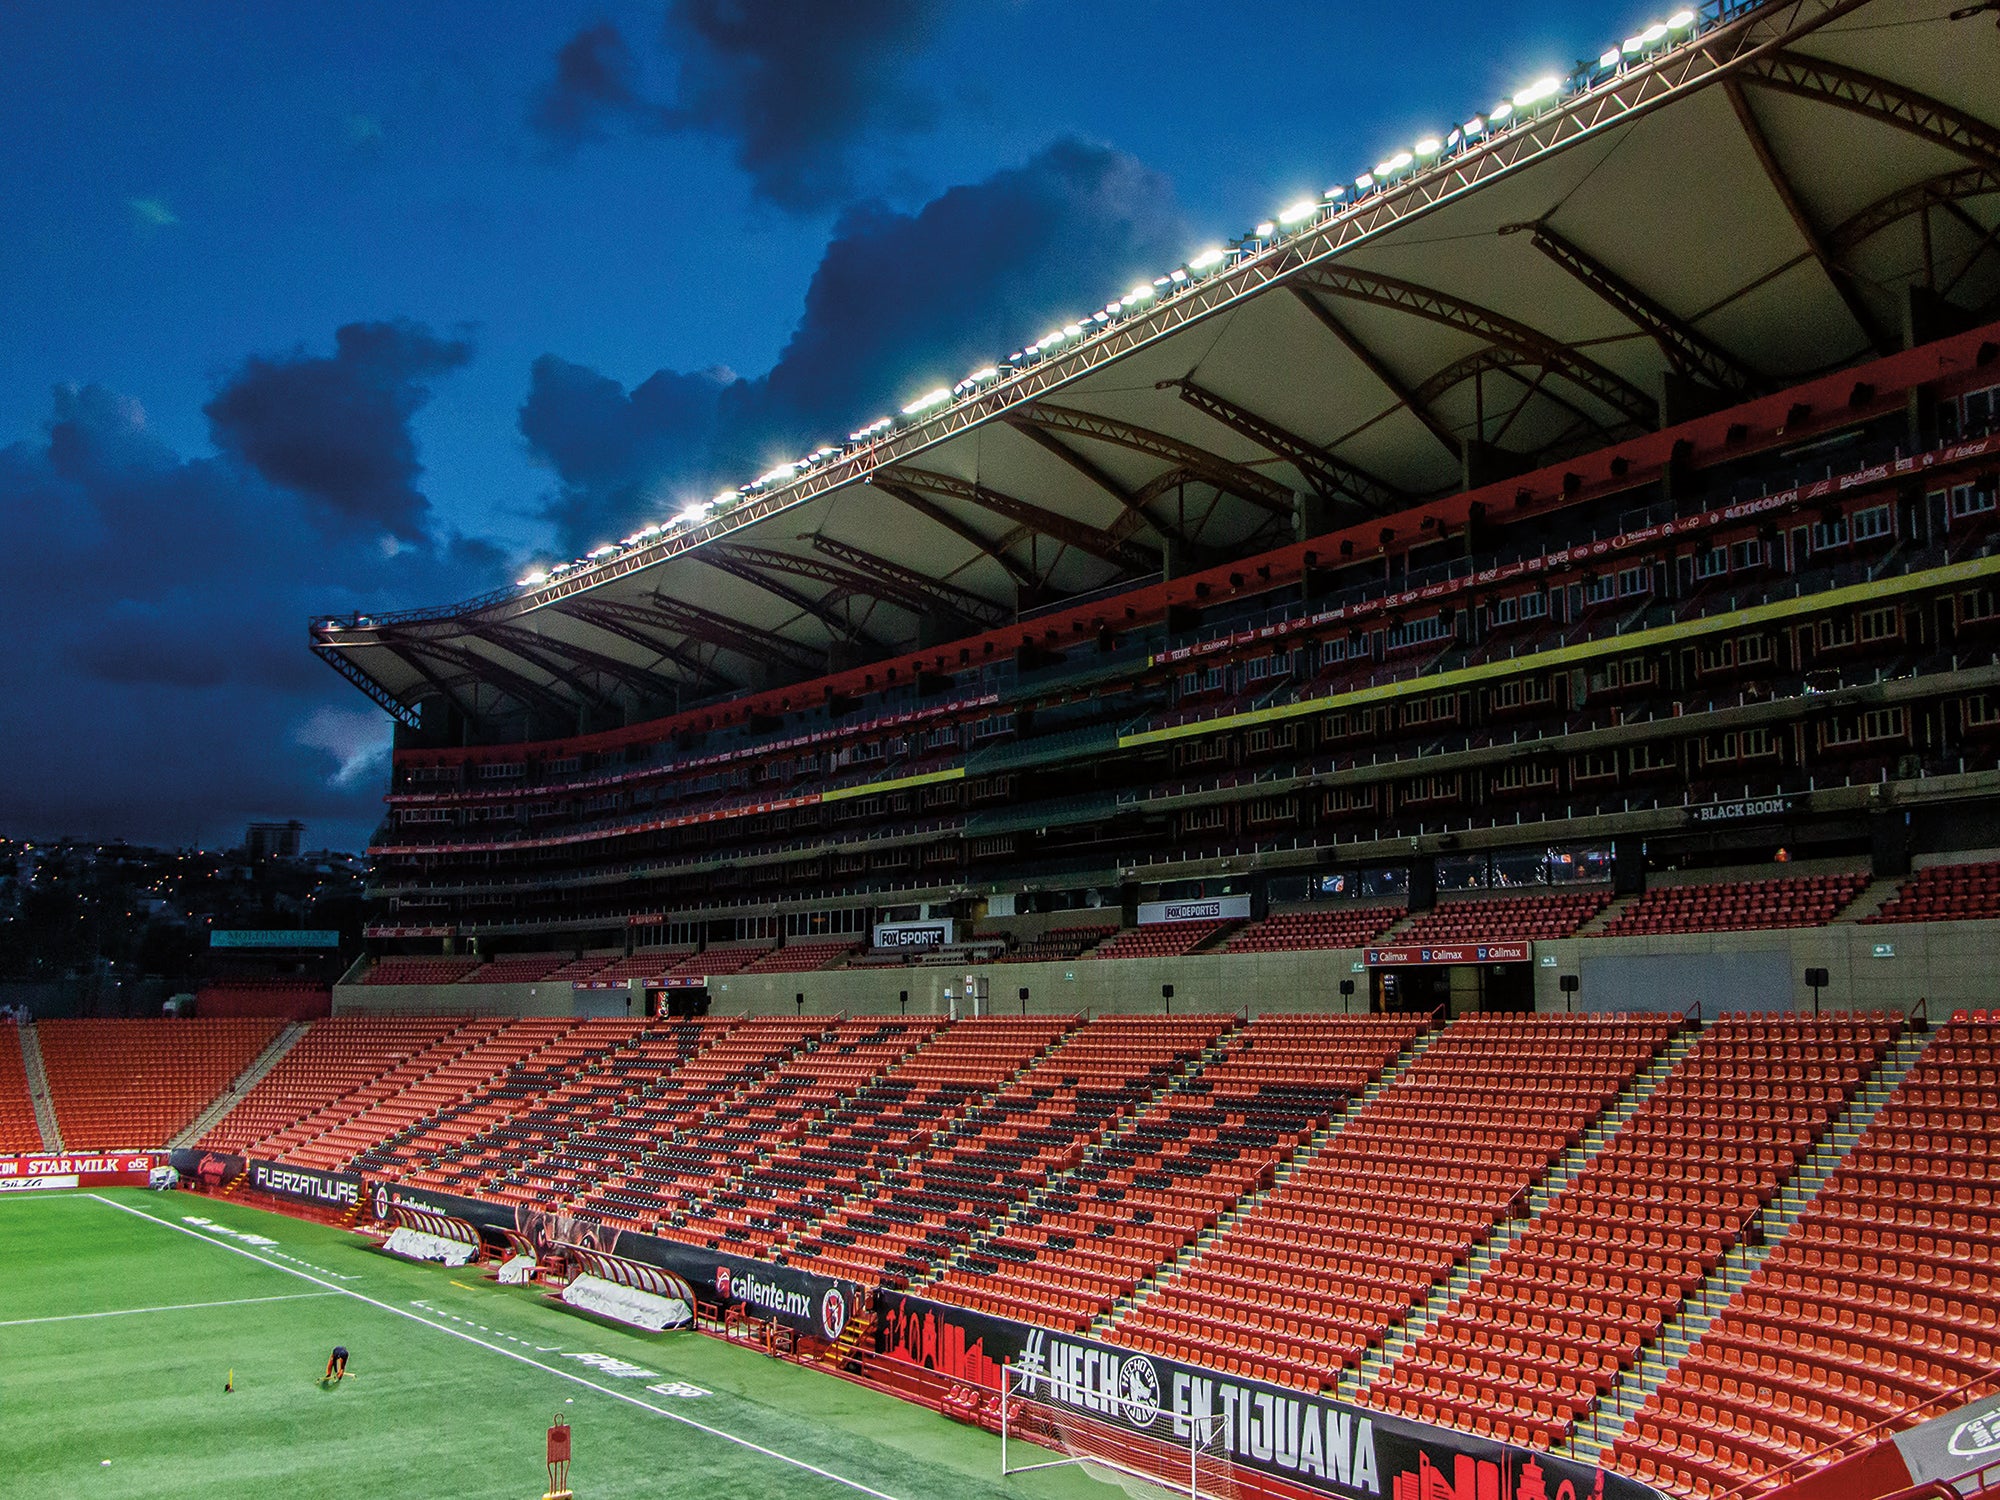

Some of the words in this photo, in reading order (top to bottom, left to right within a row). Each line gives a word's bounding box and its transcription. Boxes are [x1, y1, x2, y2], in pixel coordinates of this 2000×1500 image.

[1724, 491, 1798, 519] MEXICOACH
[1627, 529, 1657, 541] Televisa
[1171, 648, 1191, 660] TECATE
[1701, 804, 1744, 820] BLACK
[1746, 799, 1784, 816] ROOM
[1167, 907, 1181, 919] FOX
[1182, 904, 1219, 917] DEPORTES
[881, 930, 899, 947] FOX
[1379, 952, 1408, 962] Calimax
[1432, 950, 1463, 960] Calimax
[1489, 947, 1521, 958] Calimax
[28, 1160, 72, 1174] STAR
[74, 1158, 119, 1172] MILK
[128, 1158, 149, 1171] abc
[731, 1274, 811, 1318] caliente.mx
[1122, 1359, 1147, 1388] HECHO
[1173, 1371, 1213, 1446] EN
[1219, 1384, 1380, 1495] TIJUANA
